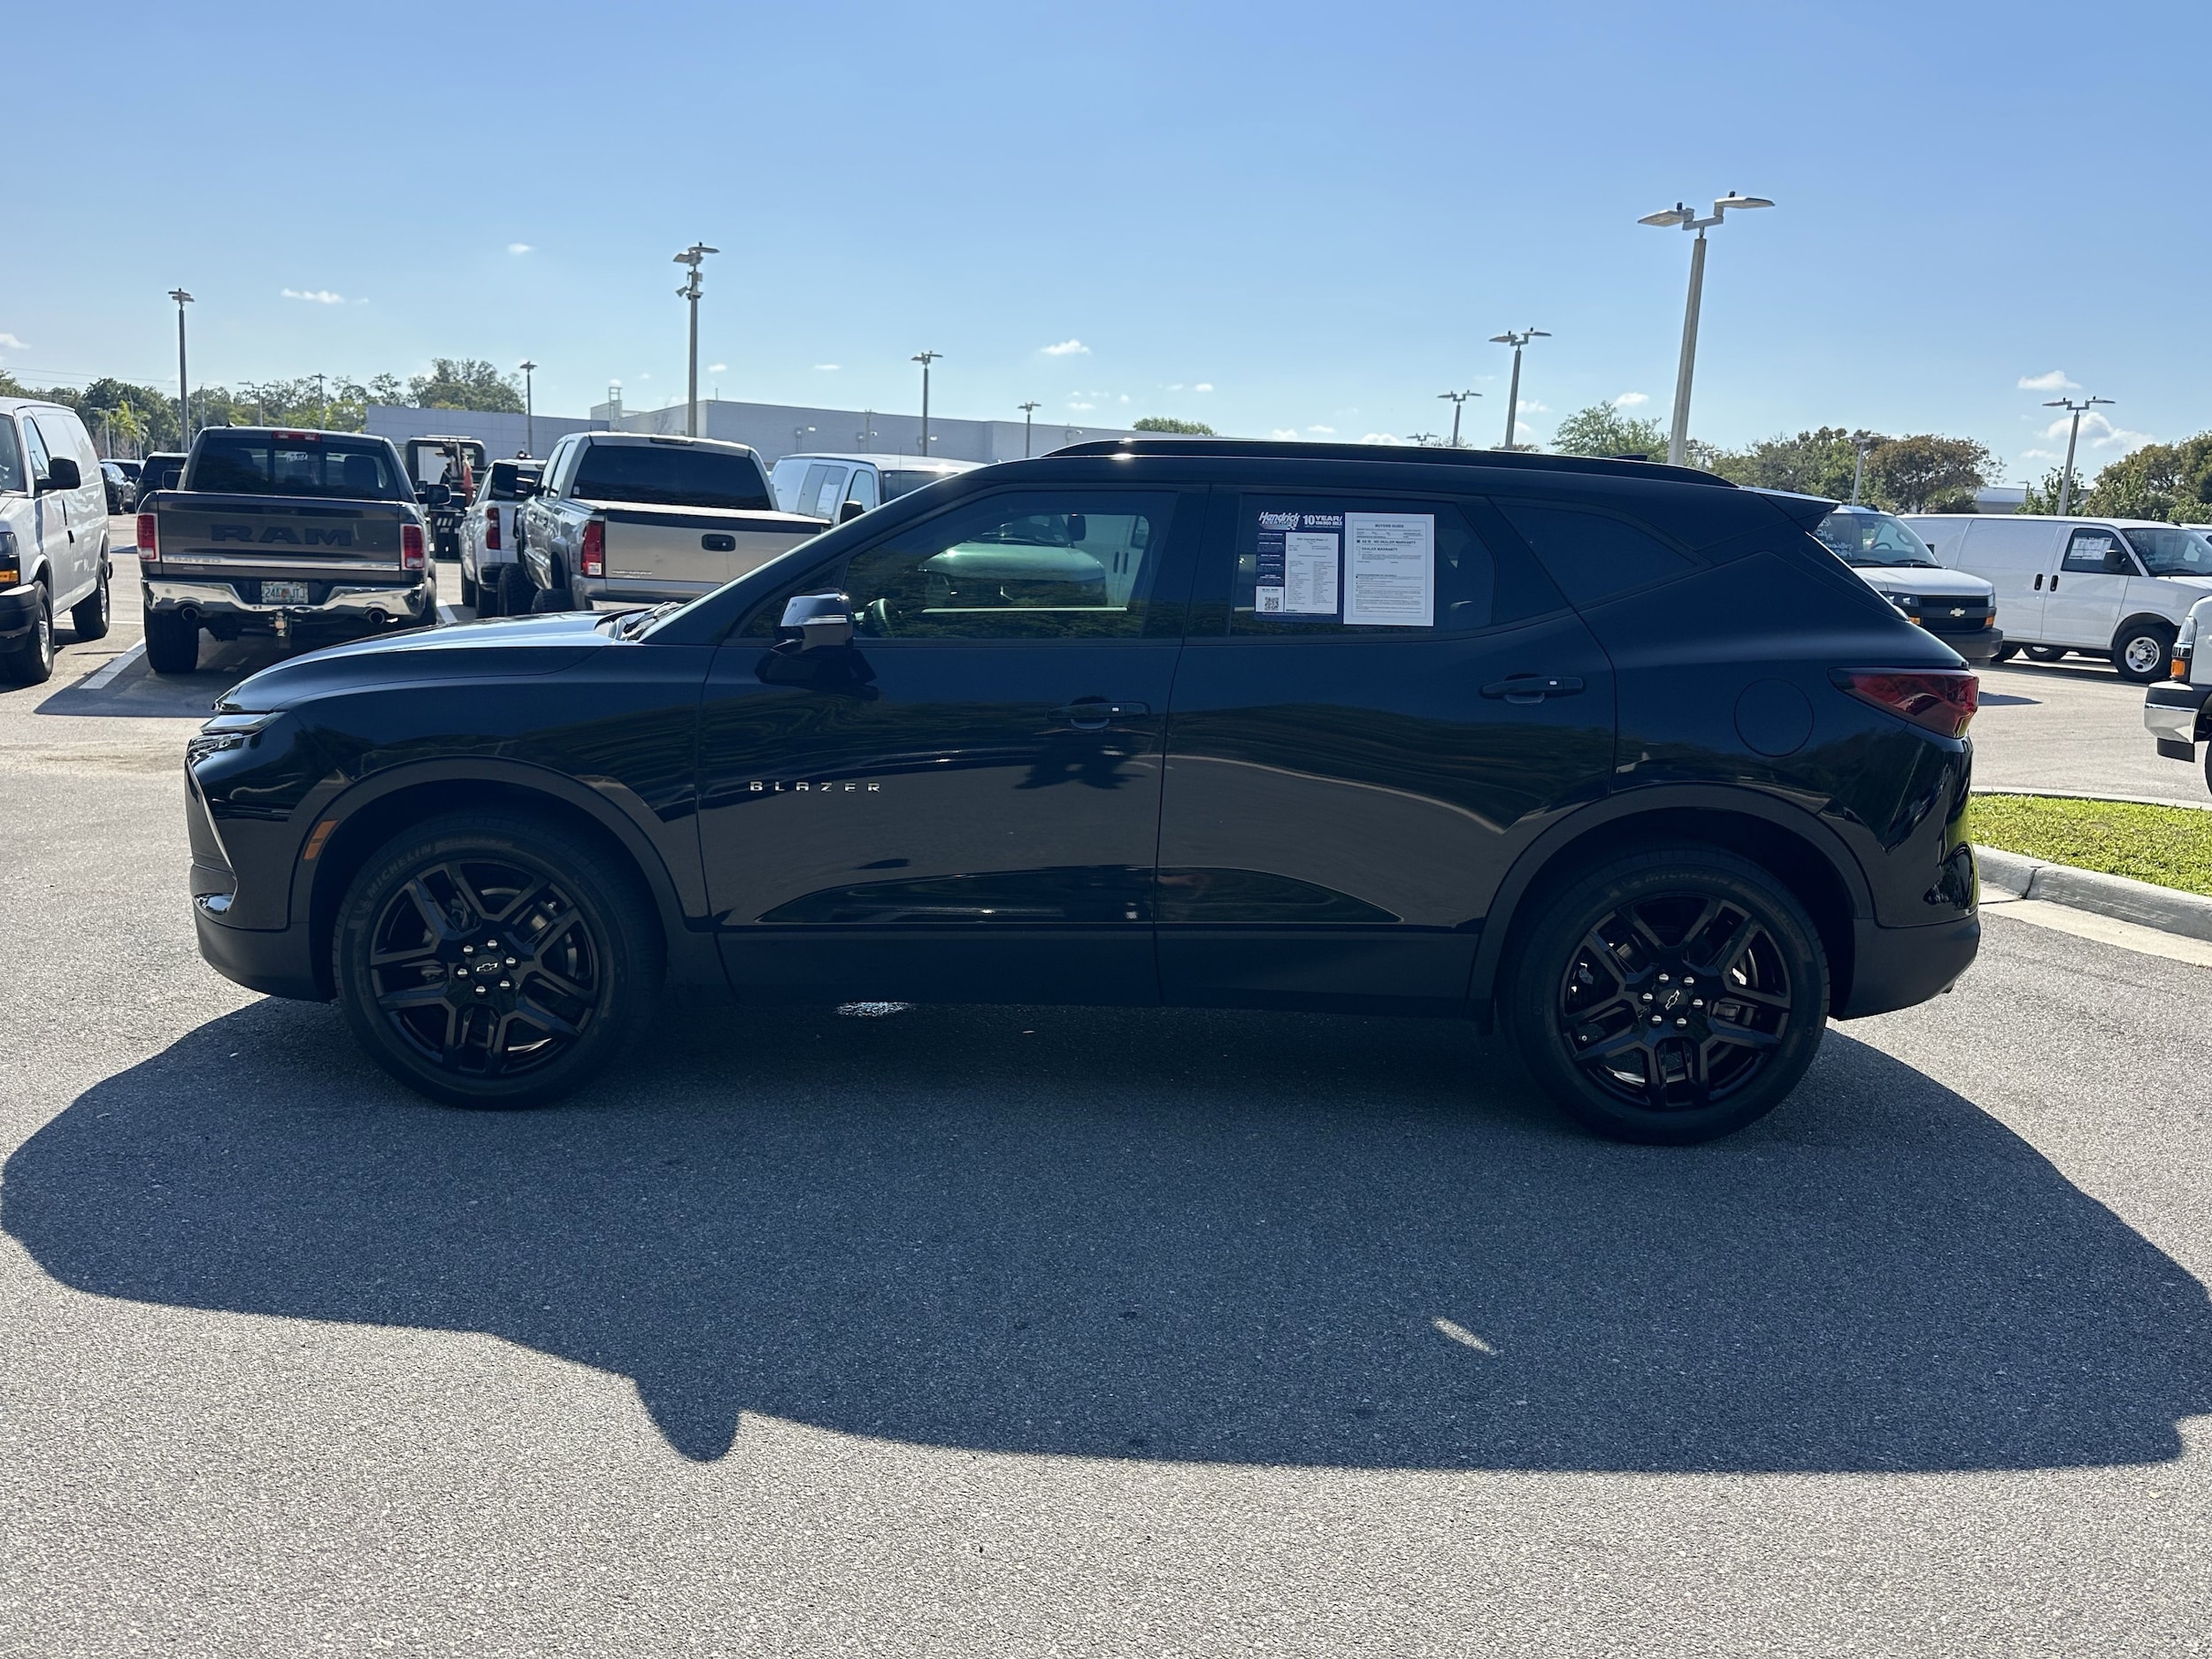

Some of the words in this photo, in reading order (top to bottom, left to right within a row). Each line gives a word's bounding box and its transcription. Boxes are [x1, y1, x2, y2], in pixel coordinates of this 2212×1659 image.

[1258, 511, 1301, 525] Hendrick
[1302, 515, 1316, 526] 10
[210, 524, 352, 546] RAM
[749, 780, 880, 793] BLAZER
[366, 842, 432, 899] MICHELIN
